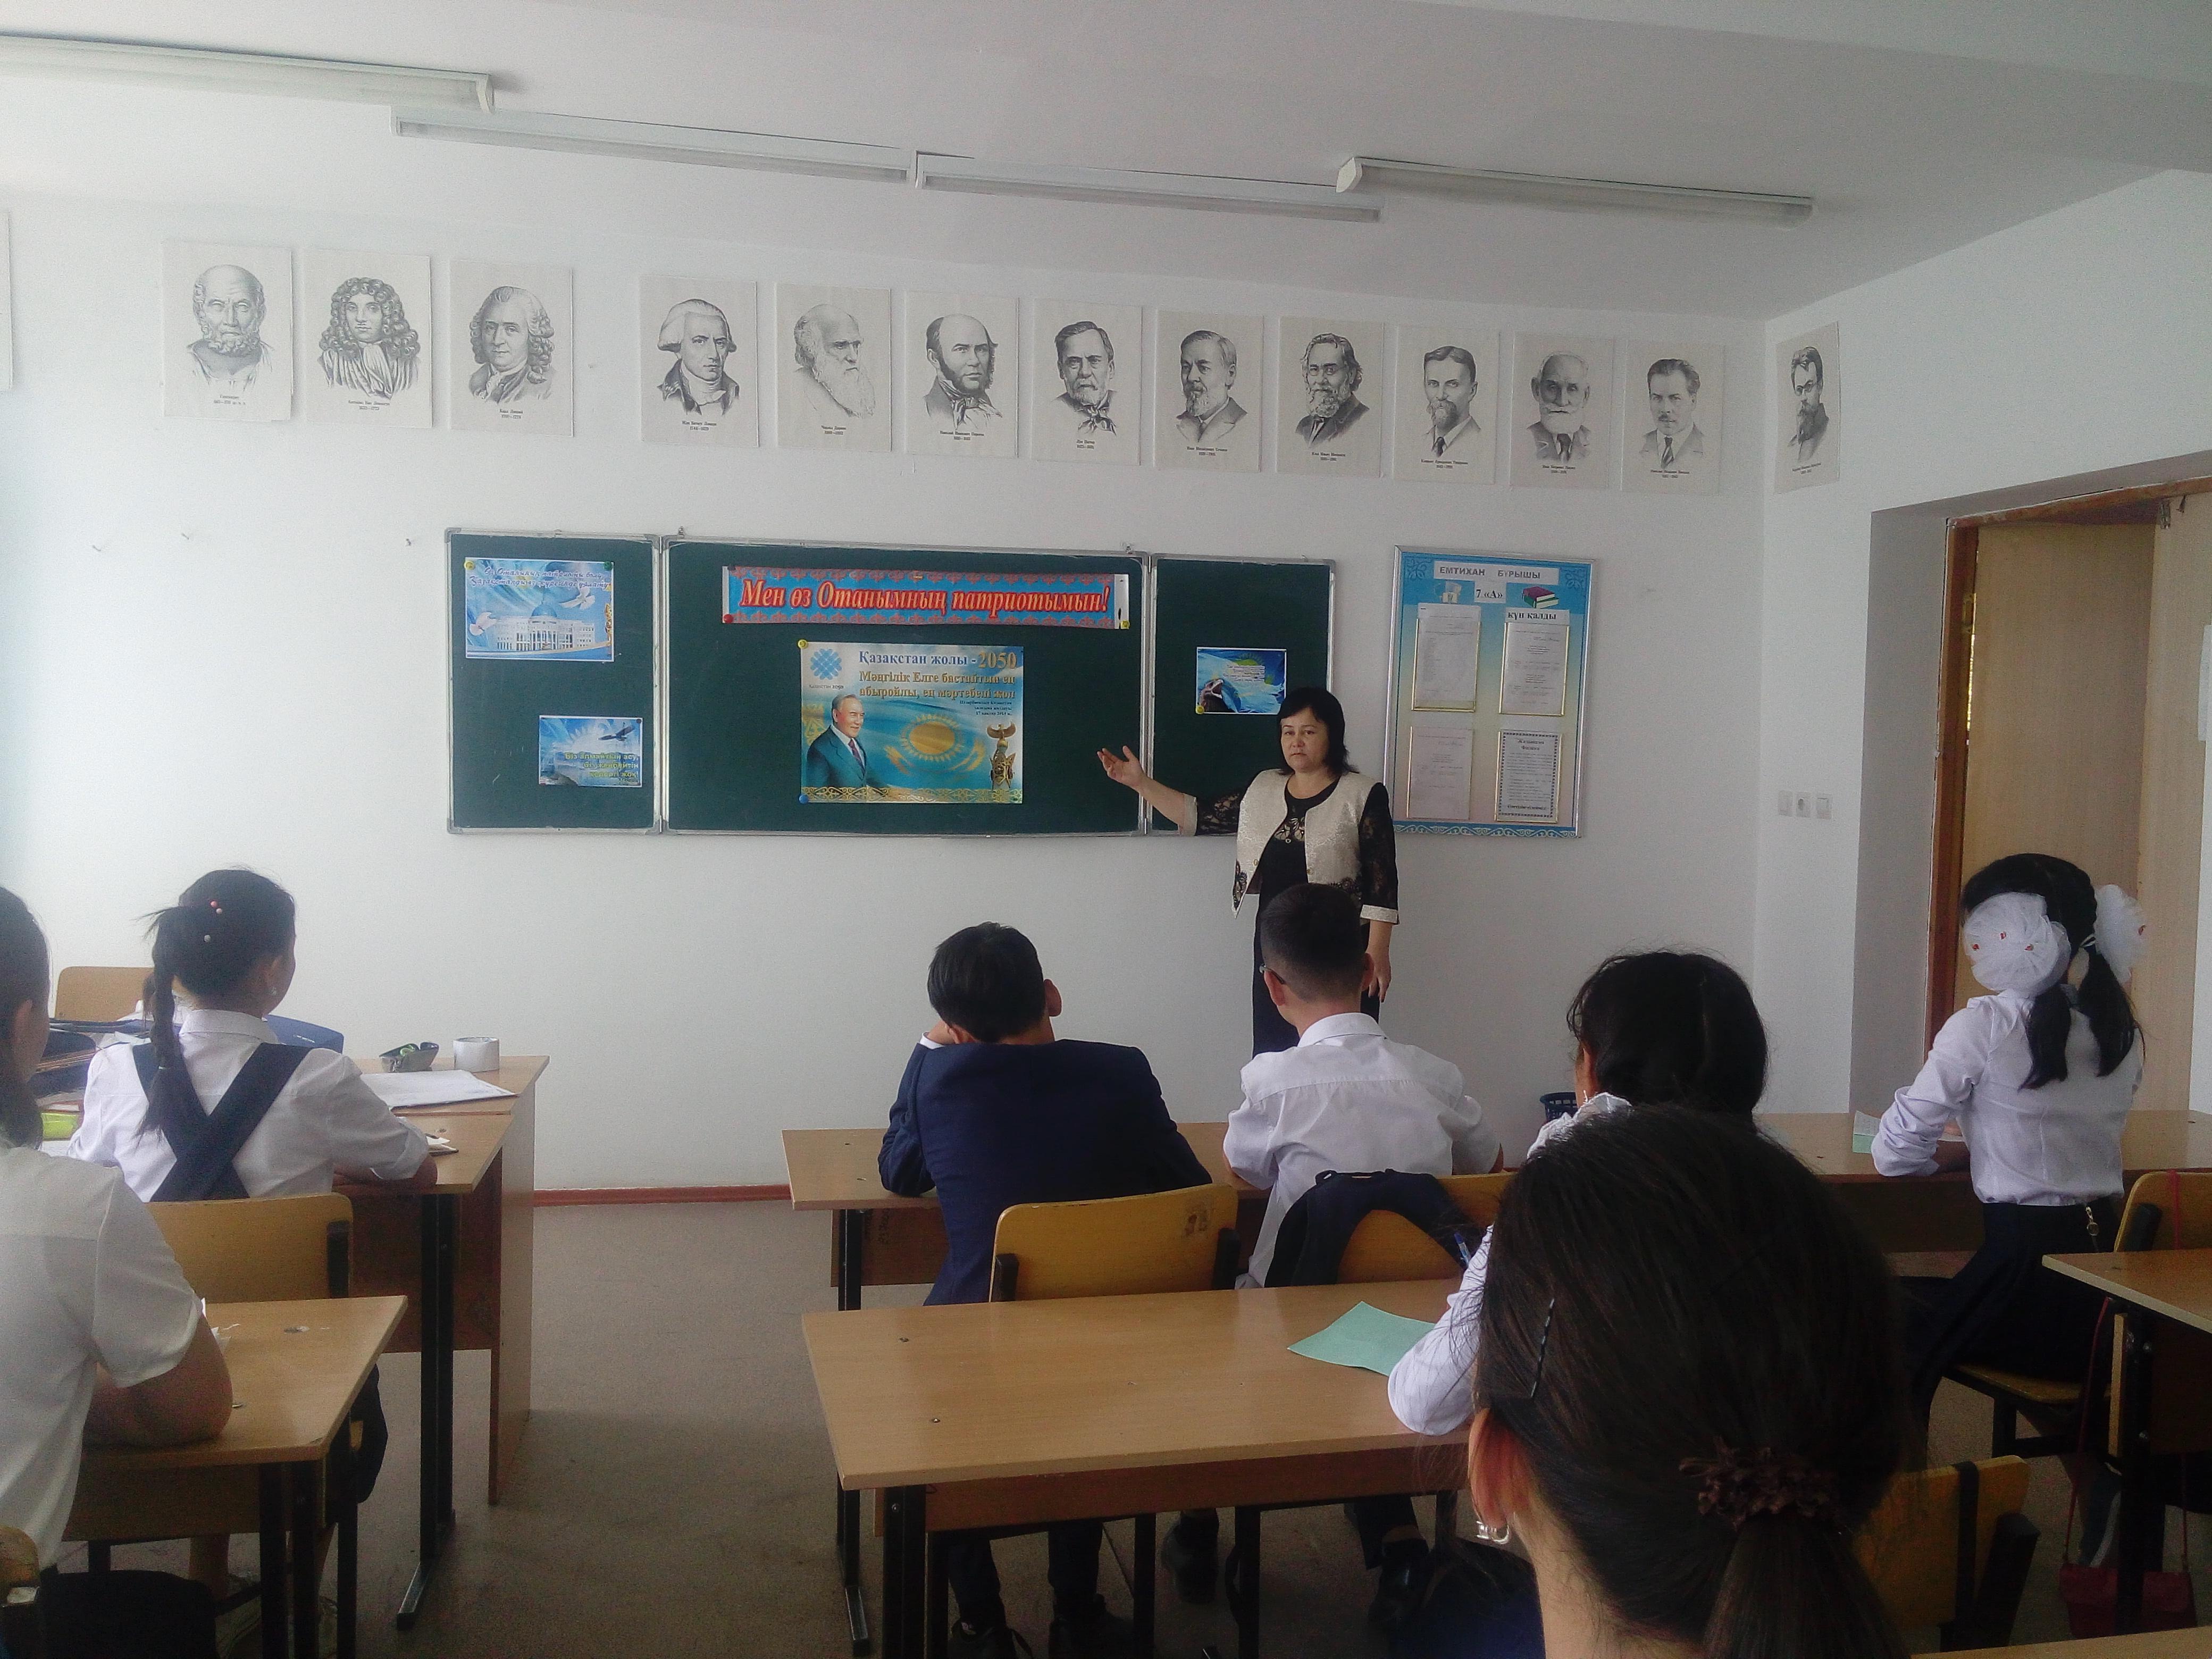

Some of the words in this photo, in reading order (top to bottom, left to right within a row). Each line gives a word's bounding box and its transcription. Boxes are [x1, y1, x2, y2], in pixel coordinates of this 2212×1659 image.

[1440, 567, 1485, 575] ЕМТИХАН
[740, 579, 786, 607] Мен
[790, 587, 812, 608] өз
[817, 581, 948, 616] Отанымның
[952, 585, 1110, 618] патриотымын!
[1476, 589, 1481, 598] 7
[1484, 590, 1503, 599] «А»
[859, 651, 926, 665] Қазақстан
[931, 655, 967, 665] жолы
[978, 651, 1017, 669] 2050
[859, 671, 910, 683] Мәңгілік
[912, 672, 939, 682] Елге
[942, 673, 1000, 683] бастайтын
[859, 685, 919, 699] абыройлы,
[939, 688, 991, 701] мәртебелі
